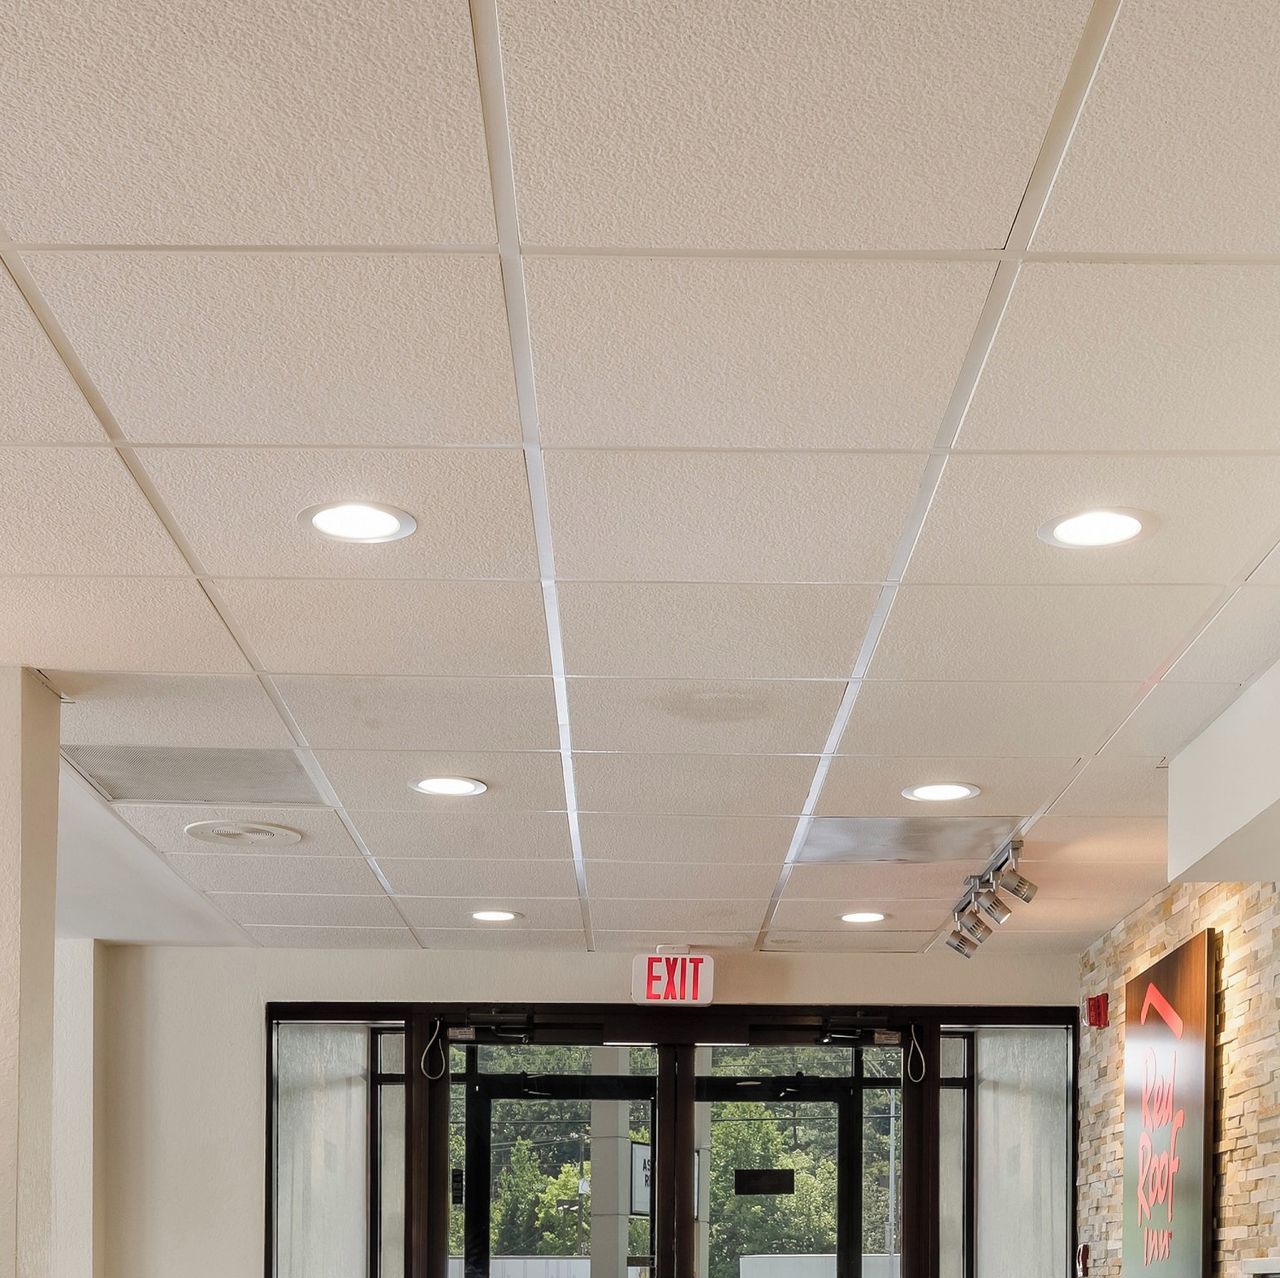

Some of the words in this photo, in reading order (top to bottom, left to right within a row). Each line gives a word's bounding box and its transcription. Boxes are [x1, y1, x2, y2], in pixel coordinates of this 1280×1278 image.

[646, 956, 704, 1001] EXIT
[1141, 1046, 1177, 1133] Red
[1137, 1108, 1185, 1228] Roof
